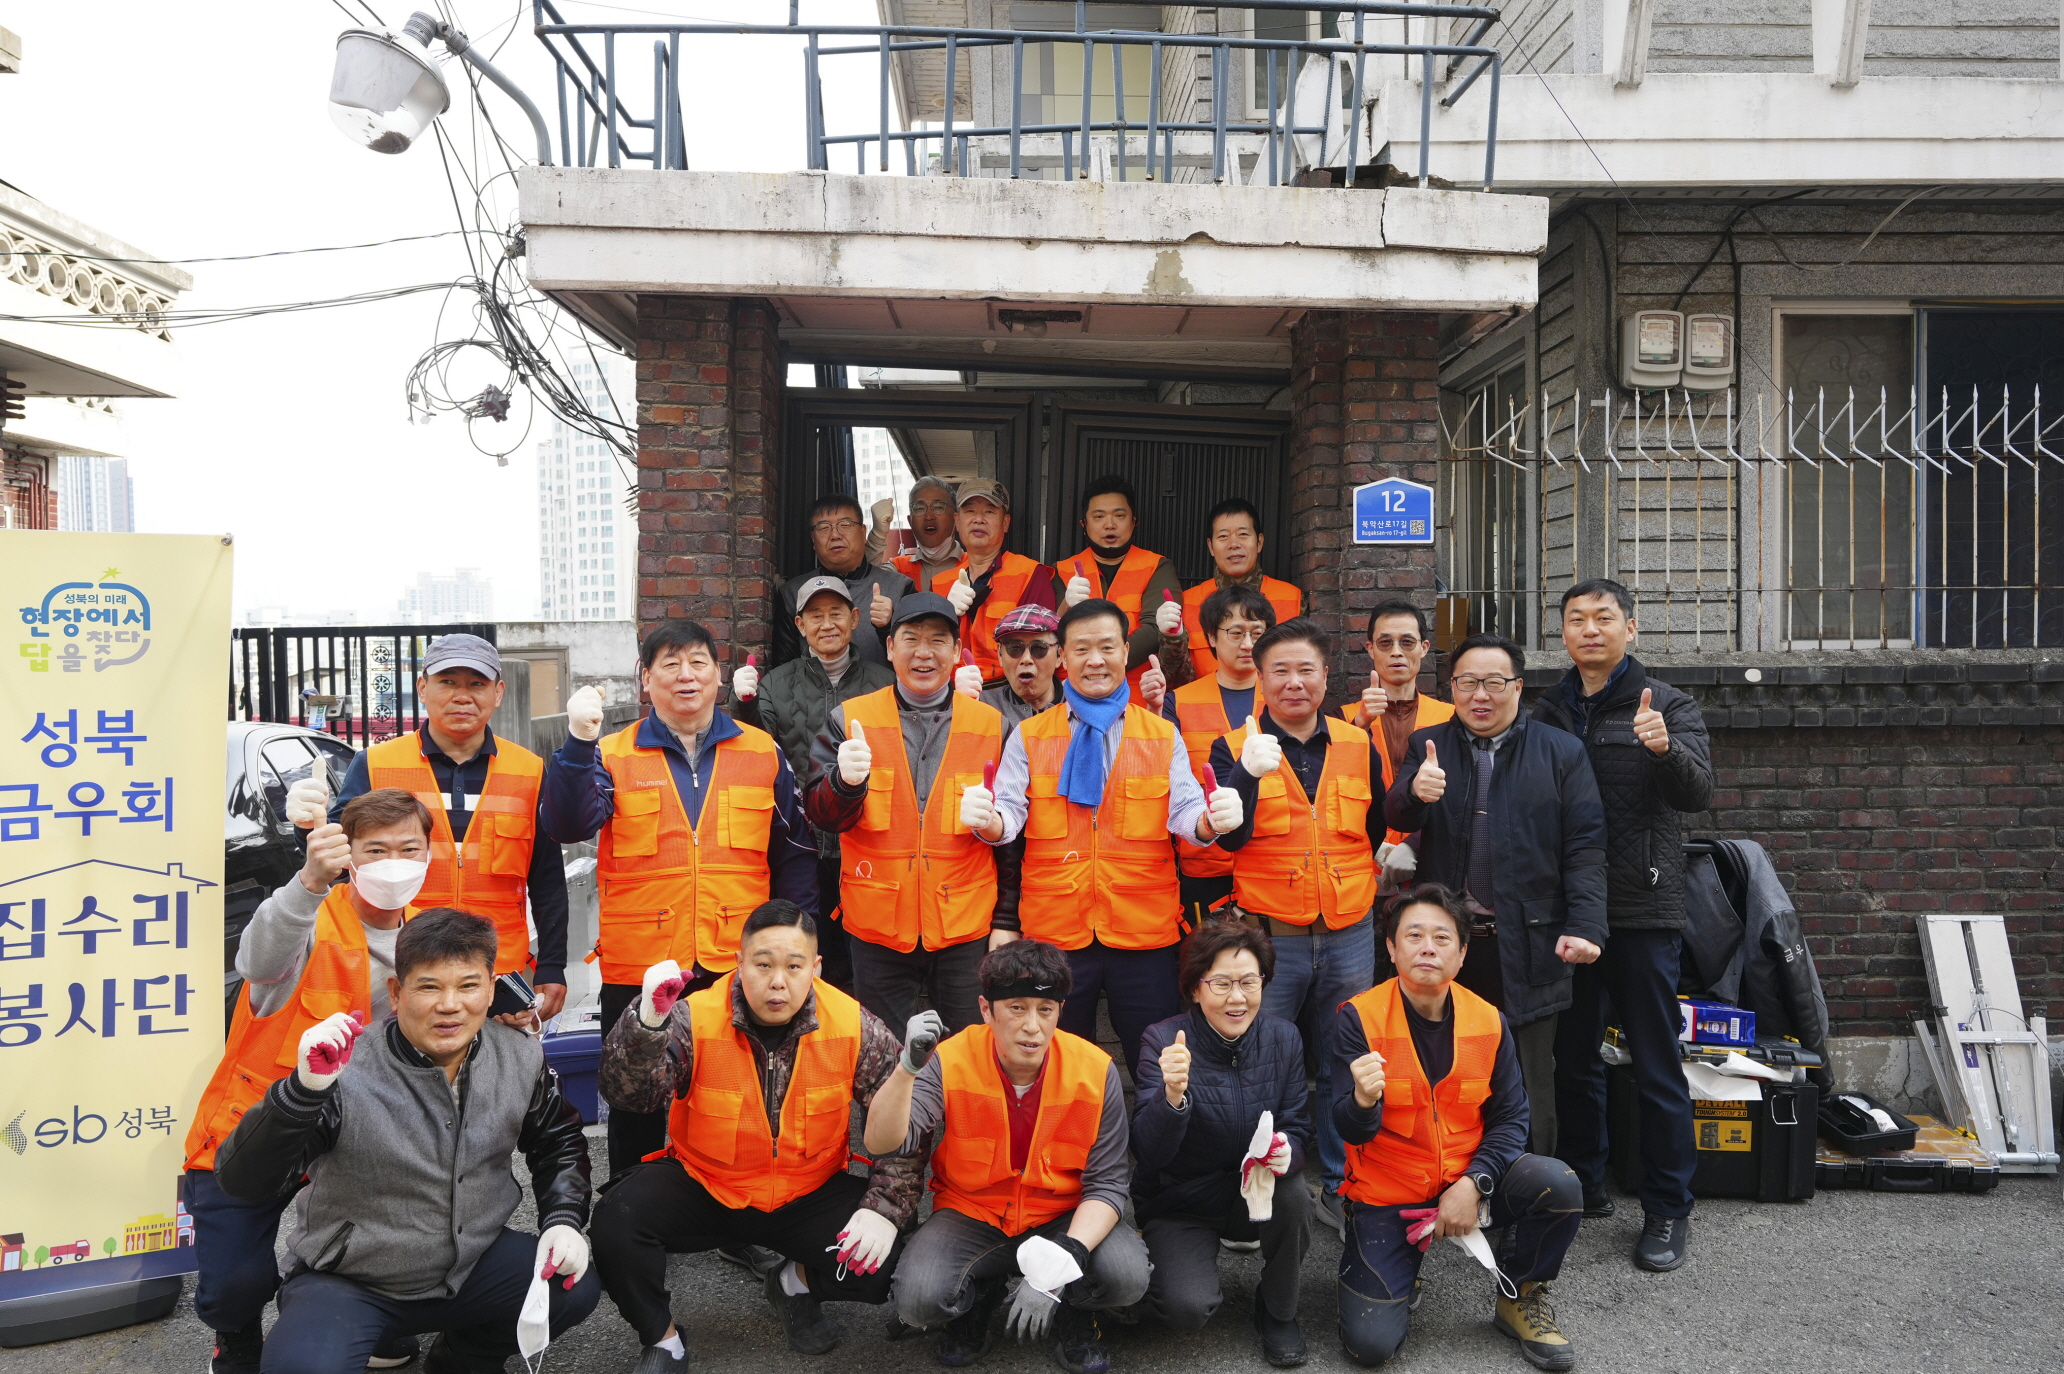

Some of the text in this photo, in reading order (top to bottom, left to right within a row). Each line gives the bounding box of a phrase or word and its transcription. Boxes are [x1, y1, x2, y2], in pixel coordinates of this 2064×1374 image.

[1381, 490, 1406, 512] 12
[1361, 520, 1407, 529] 북악산로17길
[64, 593, 127, 605] 성북의 미래
[19, 606, 150, 638] 현장에서
[19, 630, 150, 673] 답을 찾다
[21, 708, 148, 768] 성북
[636, 779, 668, 787] hummel
[0, 776, 174, 842] 금우회
[0, 890, 189, 962] 집수리
[0, 973, 196, 1048] 봉사단
[113, 1105, 178, 1139] 성북
